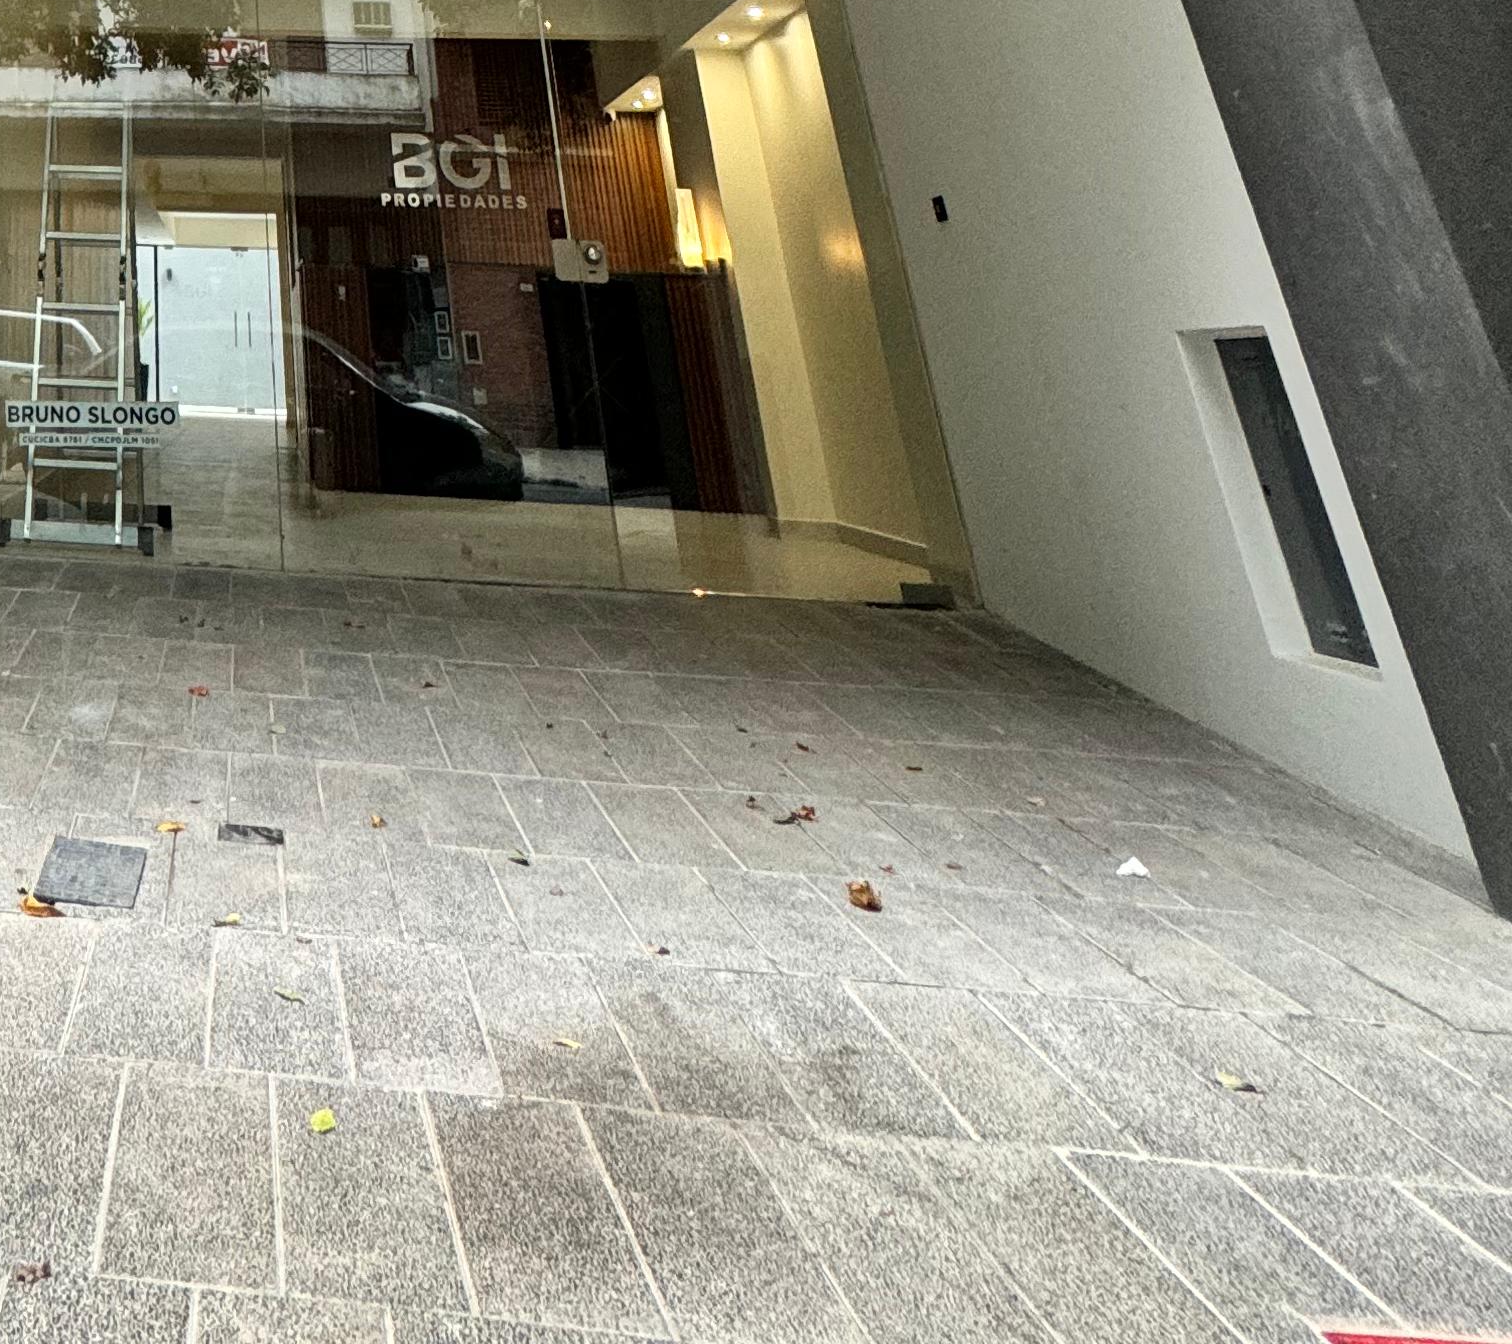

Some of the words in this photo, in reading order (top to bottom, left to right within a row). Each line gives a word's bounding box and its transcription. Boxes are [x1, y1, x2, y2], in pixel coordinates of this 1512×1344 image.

[390, 132, 512, 191] BGI
[380, 192, 528, 210] PROPIEDADES
[7, 405, 81, 424] BRUNO
[88, 406, 176, 425] SLONGO
